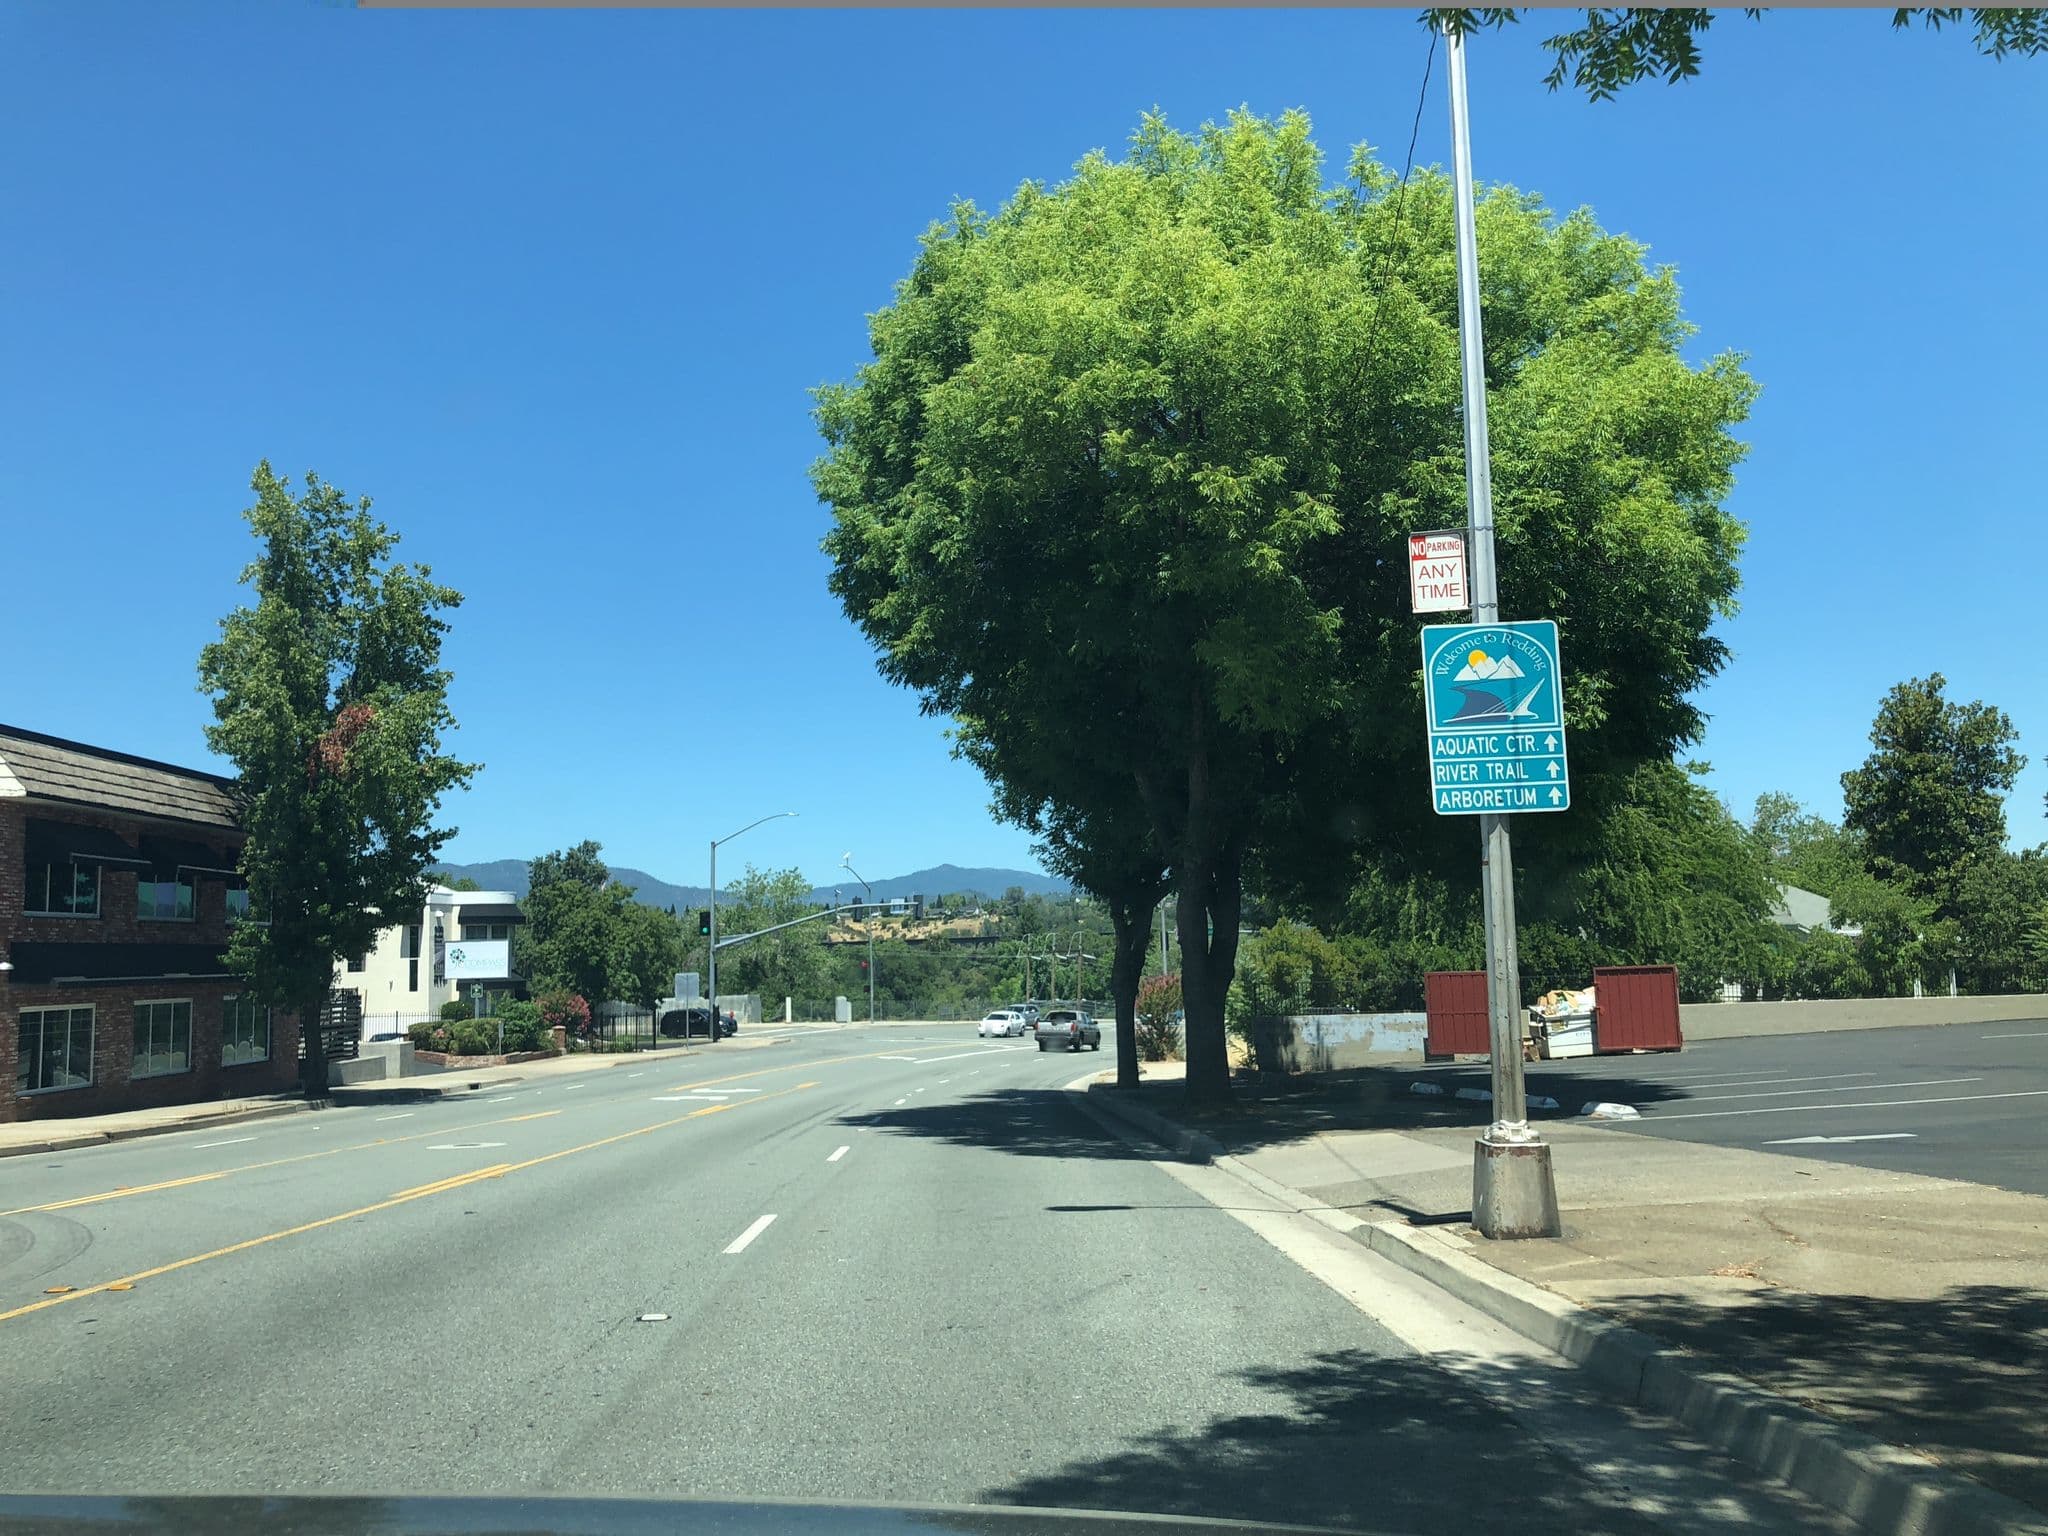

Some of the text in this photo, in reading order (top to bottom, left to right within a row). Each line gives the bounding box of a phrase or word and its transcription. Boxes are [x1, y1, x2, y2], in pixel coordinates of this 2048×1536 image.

[1411, 541, 1460, 556] NO PARKING
[1418, 562, 1457, 580] ANY
[1417, 583, 1462, 599] TIME
[1435, 633, 1547, 675] Welcome to Redding
[1435, 735, 1540, 755] AQUATIC CTR.
[1436, 762, 1529, 782] RIVER TRAIL
[1440, 788, 1537, 808] ARBORETUM
